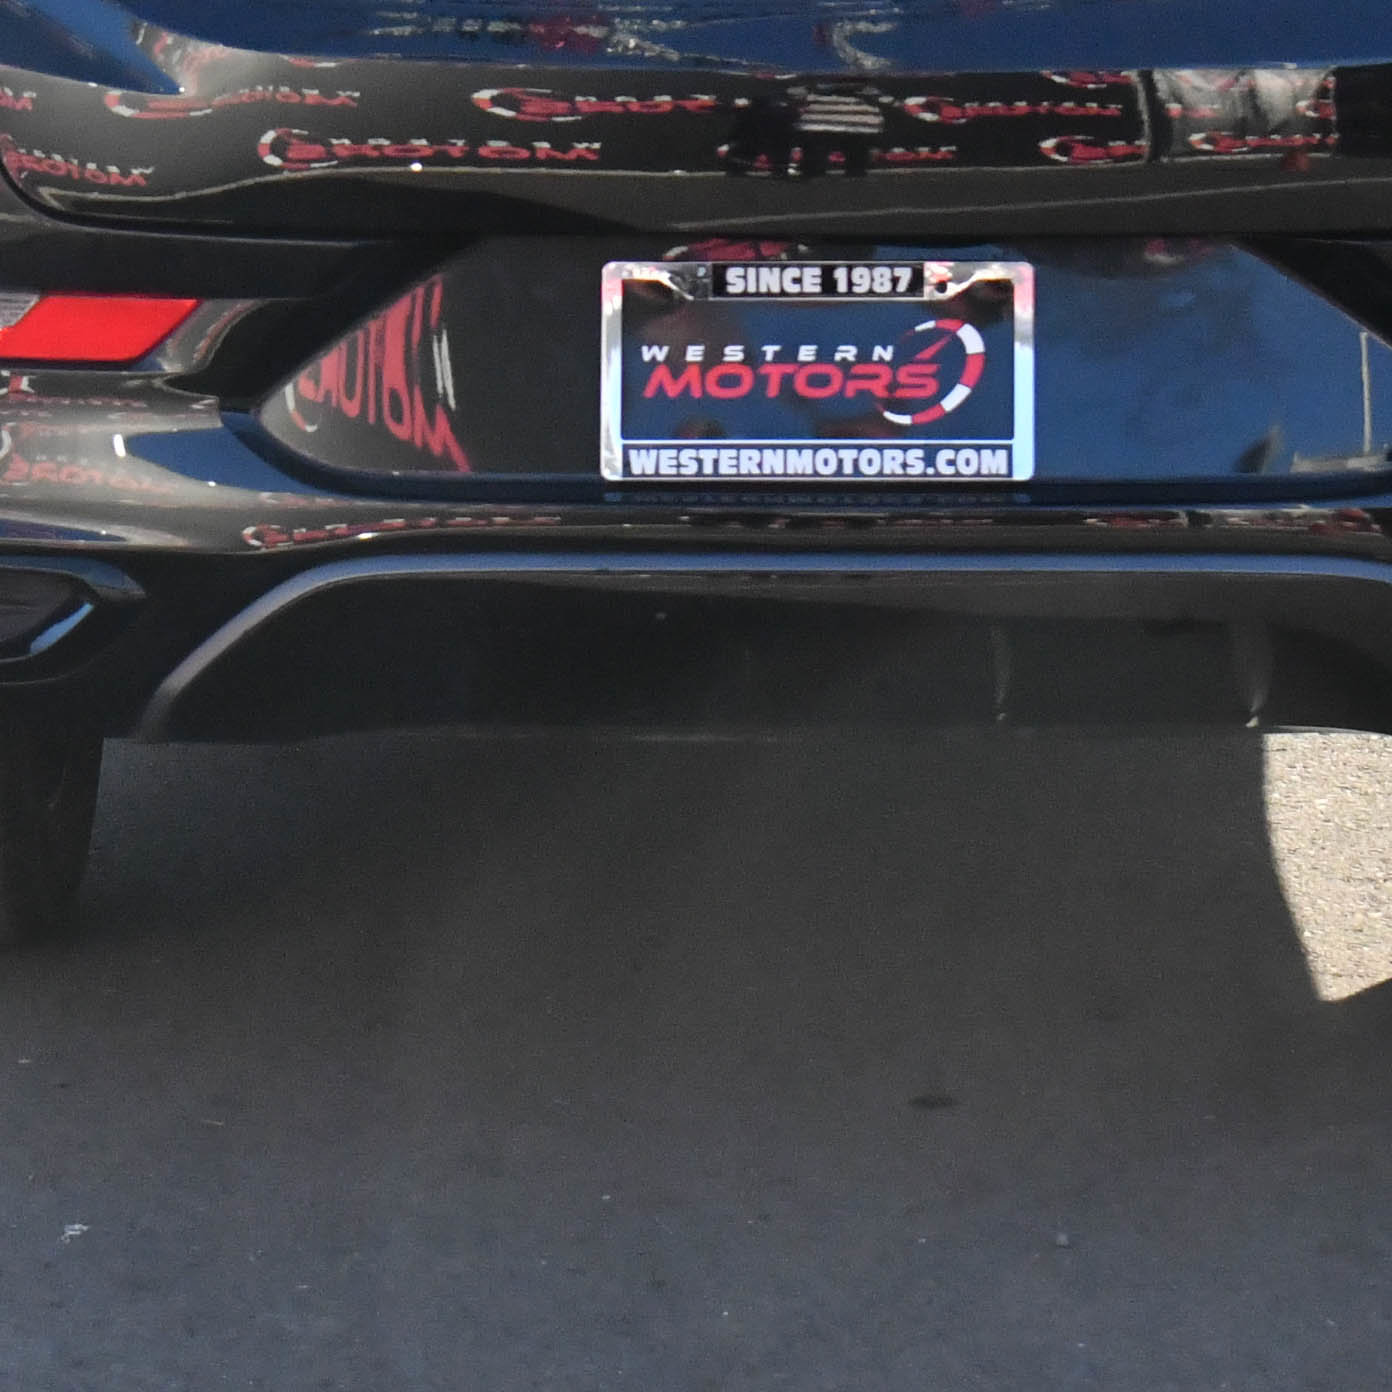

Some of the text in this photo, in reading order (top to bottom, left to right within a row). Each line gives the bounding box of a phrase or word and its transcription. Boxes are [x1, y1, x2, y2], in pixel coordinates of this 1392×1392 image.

[725, 266, 913, 295] SINCE 1987
[641, 344, 894, 363] WESTERN
[642, 363, 940, 399] MOTORS
[628, 447, 1008, 477] WESTERNMOTORS.COM
